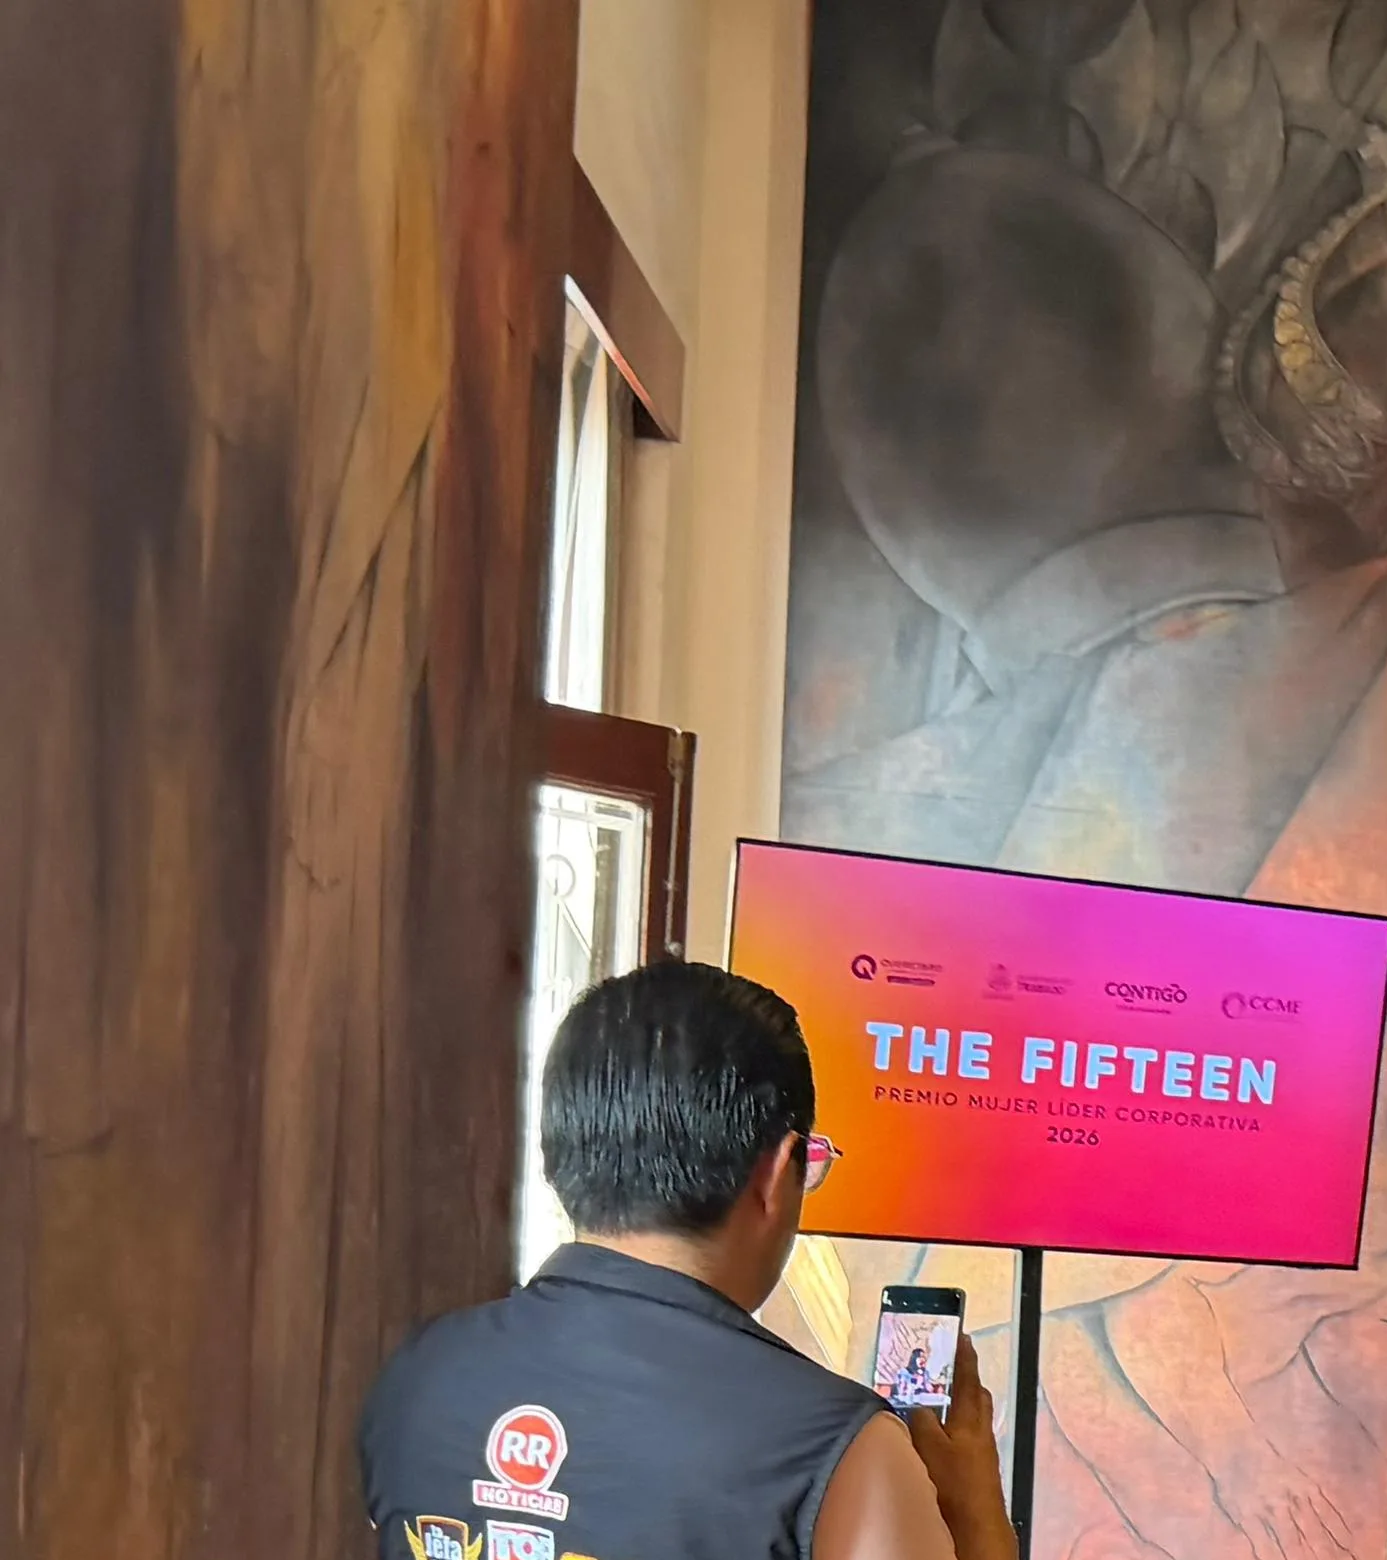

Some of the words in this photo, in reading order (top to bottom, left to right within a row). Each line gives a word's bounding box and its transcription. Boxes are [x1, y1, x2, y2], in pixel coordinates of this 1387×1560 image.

[866, 1021, 992, 1079] THE
[1021, 1037, 1277, 1105] FIFTEEN
[874, 1086, 958, 1107] PREMIO
[968, 1095, 1038, 1114] MUJER
[1047, 1098, 1106, 1120] LÍDER
[1115, 1107, 1261, 1133] CORPORATIVA
[1046, 1127, 1099, 1146] 2026
[501, 1429, 552, 1470] RR
[481, 1486, 563, 1514] NOTICIAS
